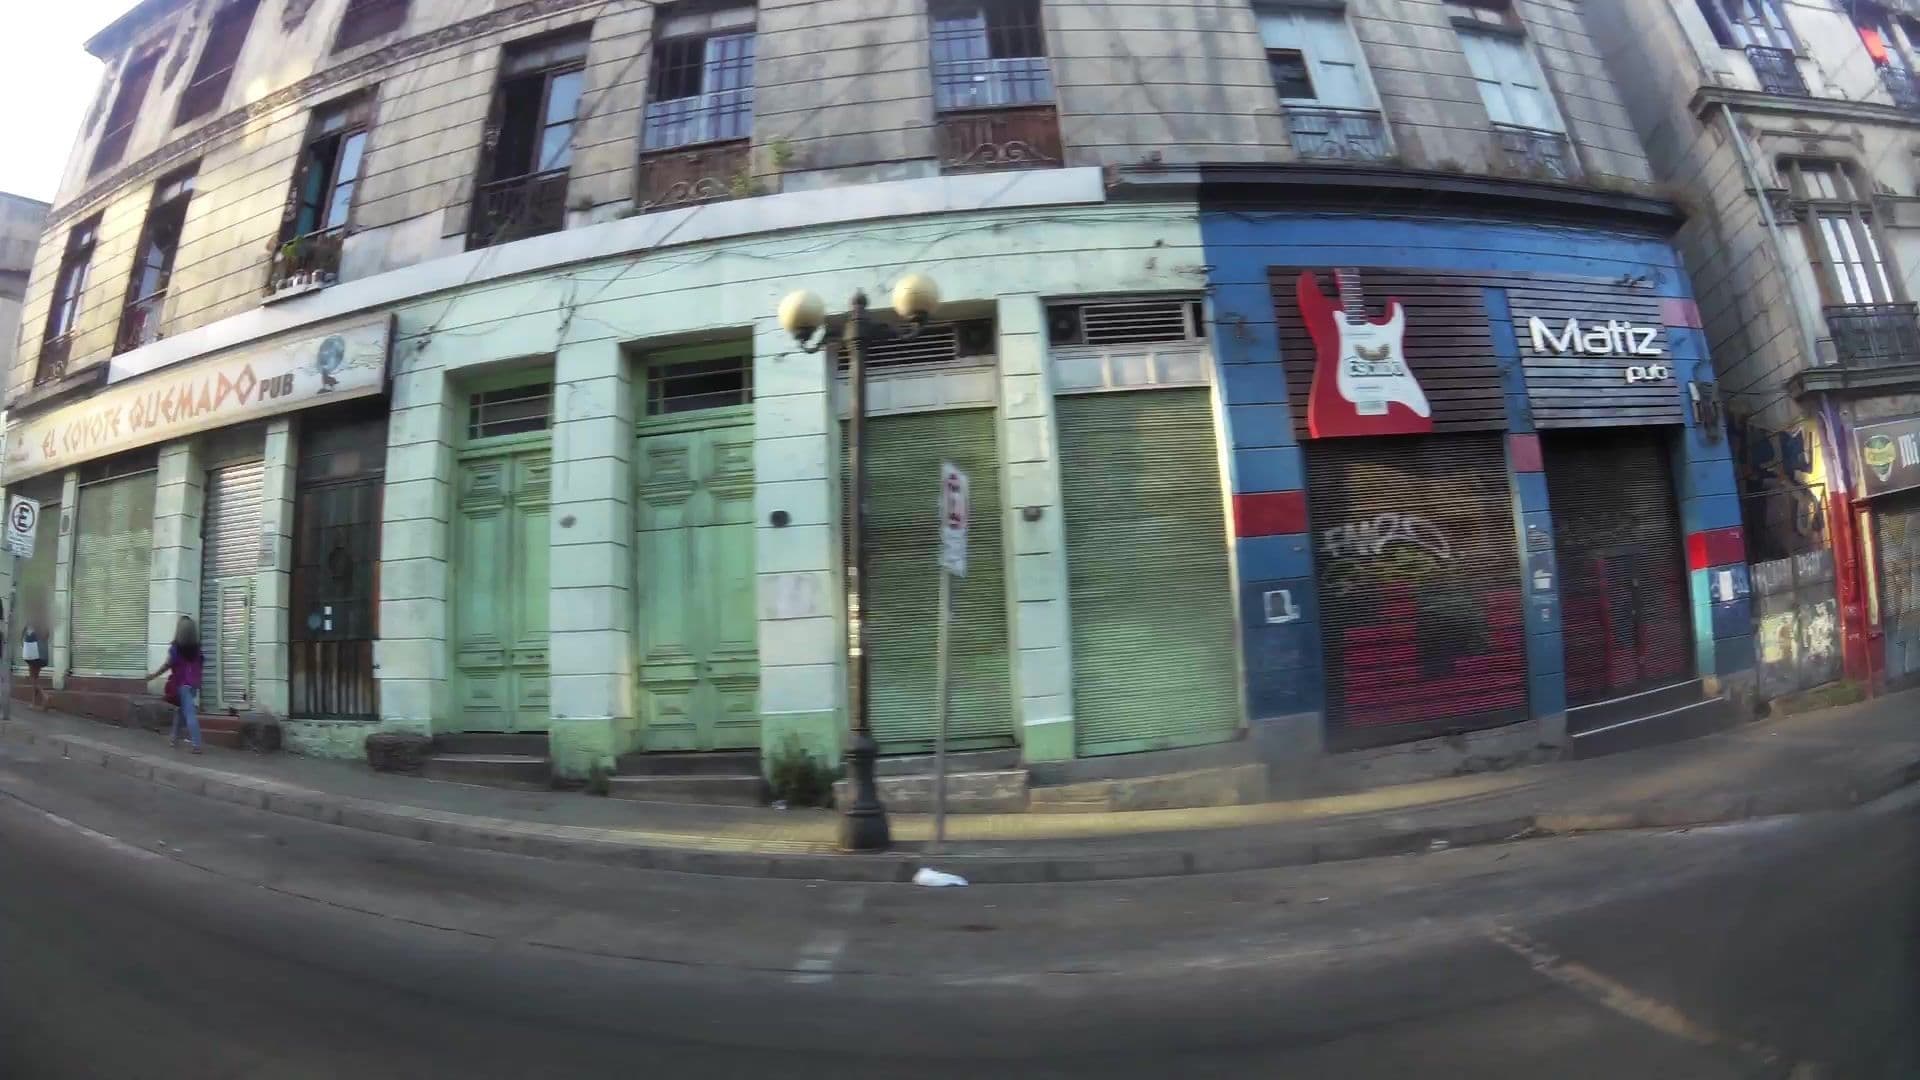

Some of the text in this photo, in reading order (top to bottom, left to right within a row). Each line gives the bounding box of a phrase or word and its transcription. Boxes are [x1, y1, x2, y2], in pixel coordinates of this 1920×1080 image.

[1528, 316, 1664, 355] Matiz
[1626, 364, 1669, 383] pub
[42, 363, 294, 458] EL COYOTE QUEMADO PUB
[18, 506, 30, 528] E
